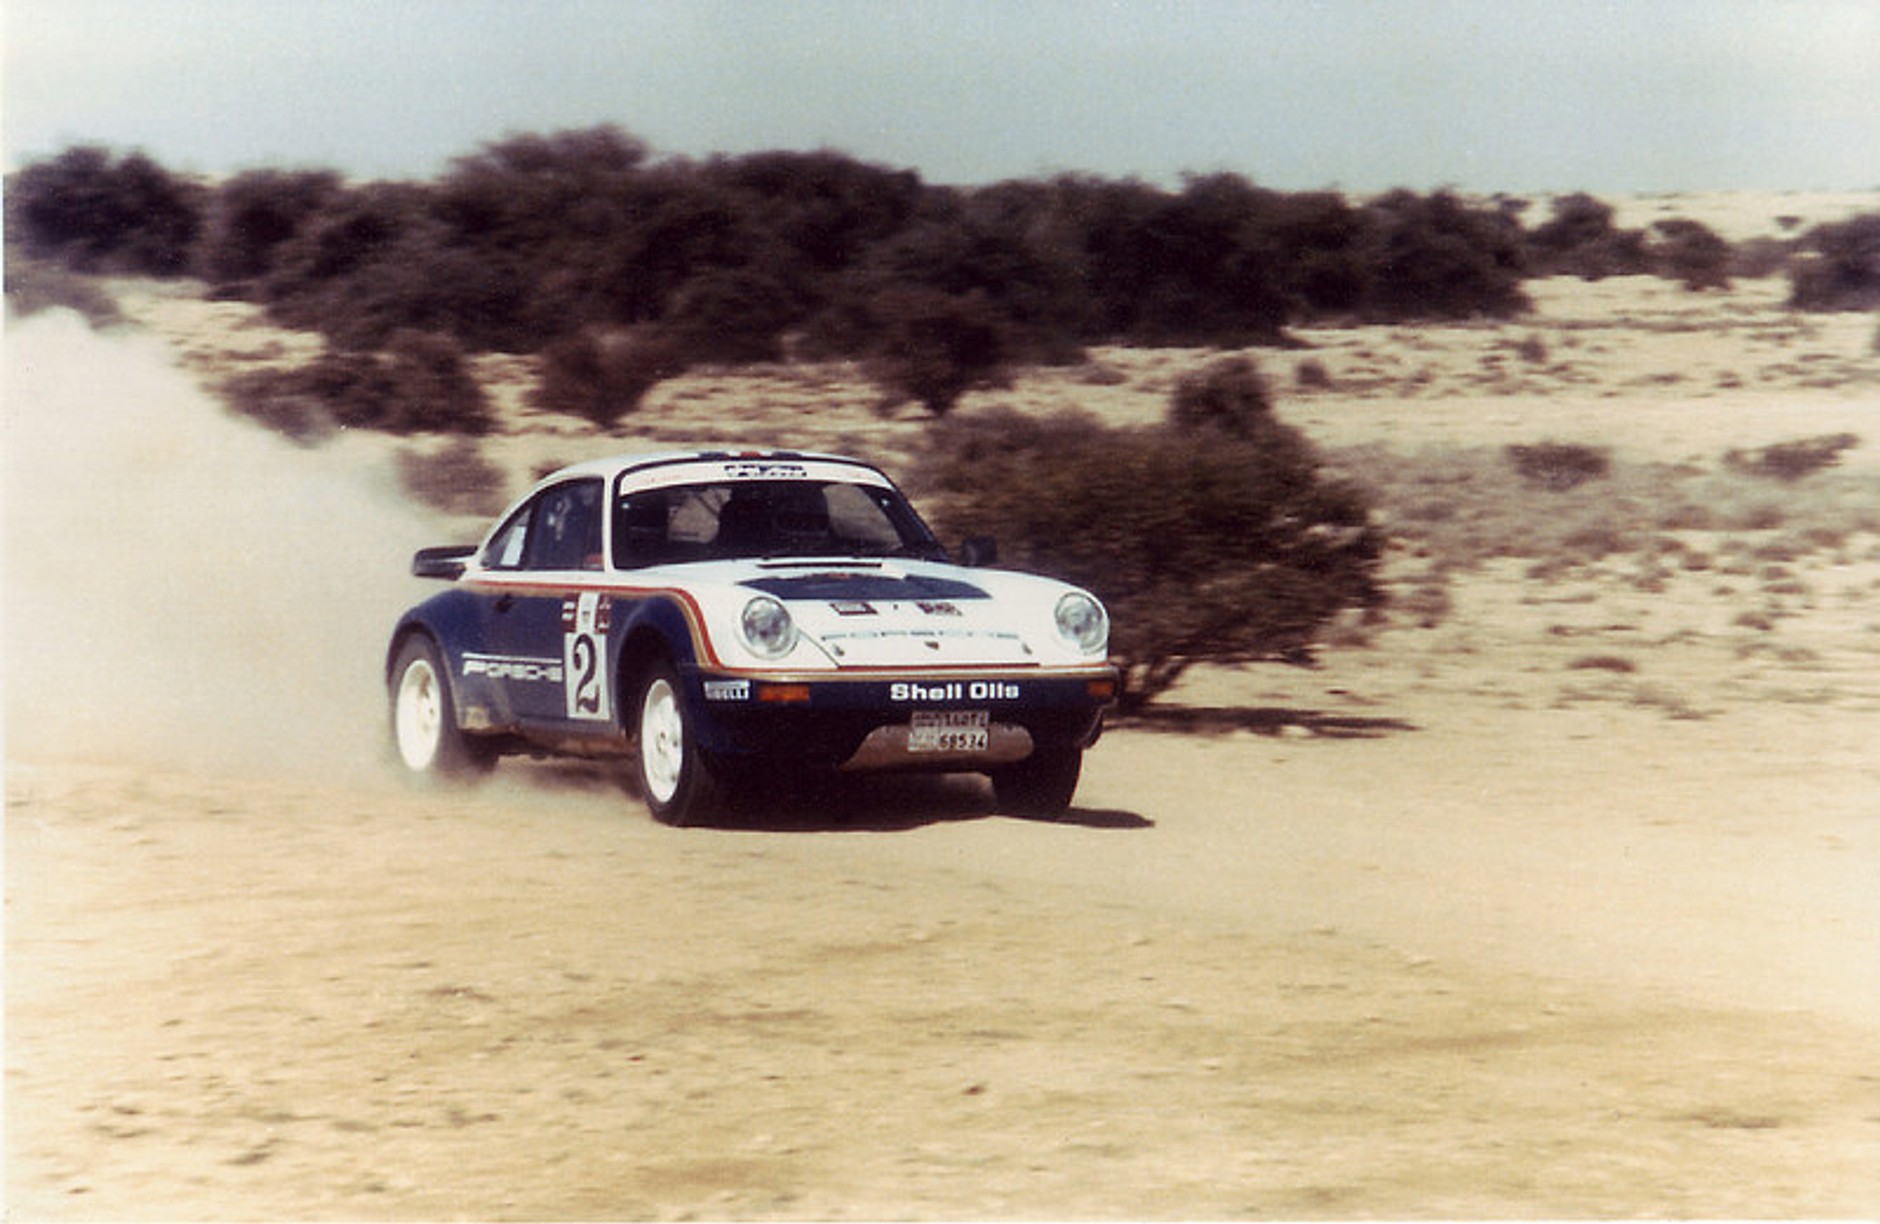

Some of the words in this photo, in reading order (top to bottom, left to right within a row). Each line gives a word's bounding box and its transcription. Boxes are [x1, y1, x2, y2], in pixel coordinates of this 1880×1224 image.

[463, 660, 563, 682] PORSCHE
[573, 633, 600, 714] 2
[891, 683, 962, 700] Shell
[969, 682, 1019, 700] Oils
